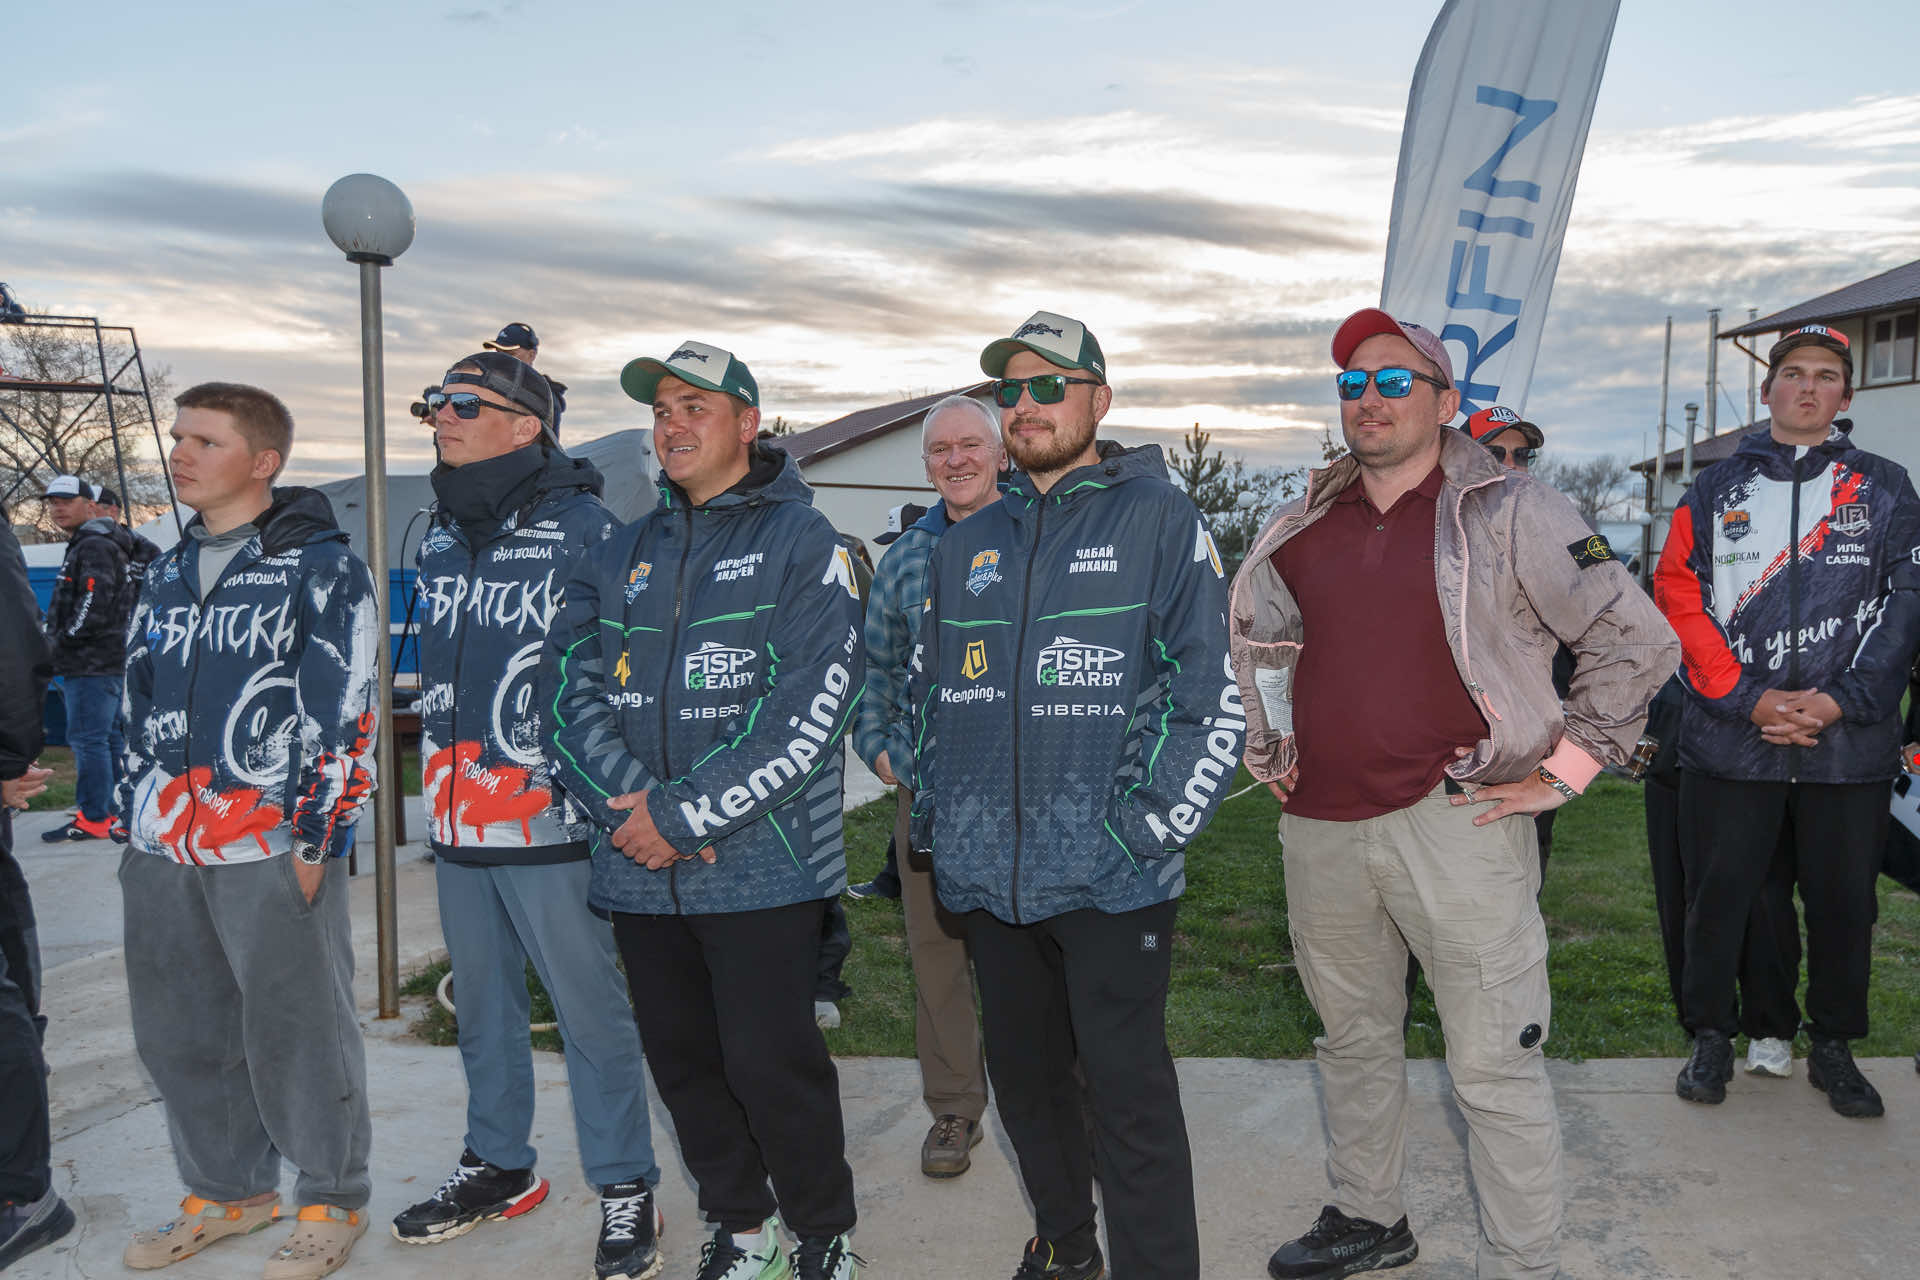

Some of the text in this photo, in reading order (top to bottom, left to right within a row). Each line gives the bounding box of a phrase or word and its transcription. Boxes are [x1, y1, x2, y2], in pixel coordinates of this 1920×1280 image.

[1440, 85, 1558, 417] RFIN
[1076, 544, 1114, 560] ЧАБАЙ
[1825, 554, 1871, 566] САЗАНВ
[713, 552, 764, 572] МАРКВИЧ
[1069, 559, 1118, 574] МИХАИЛ
[685, 651, 748, 689] FISH
[1037, 646, 1110, 686] FISH
[680, 703, 748, 720] SIBERI
[1031, 704, 1126, 717] SIBERIA
